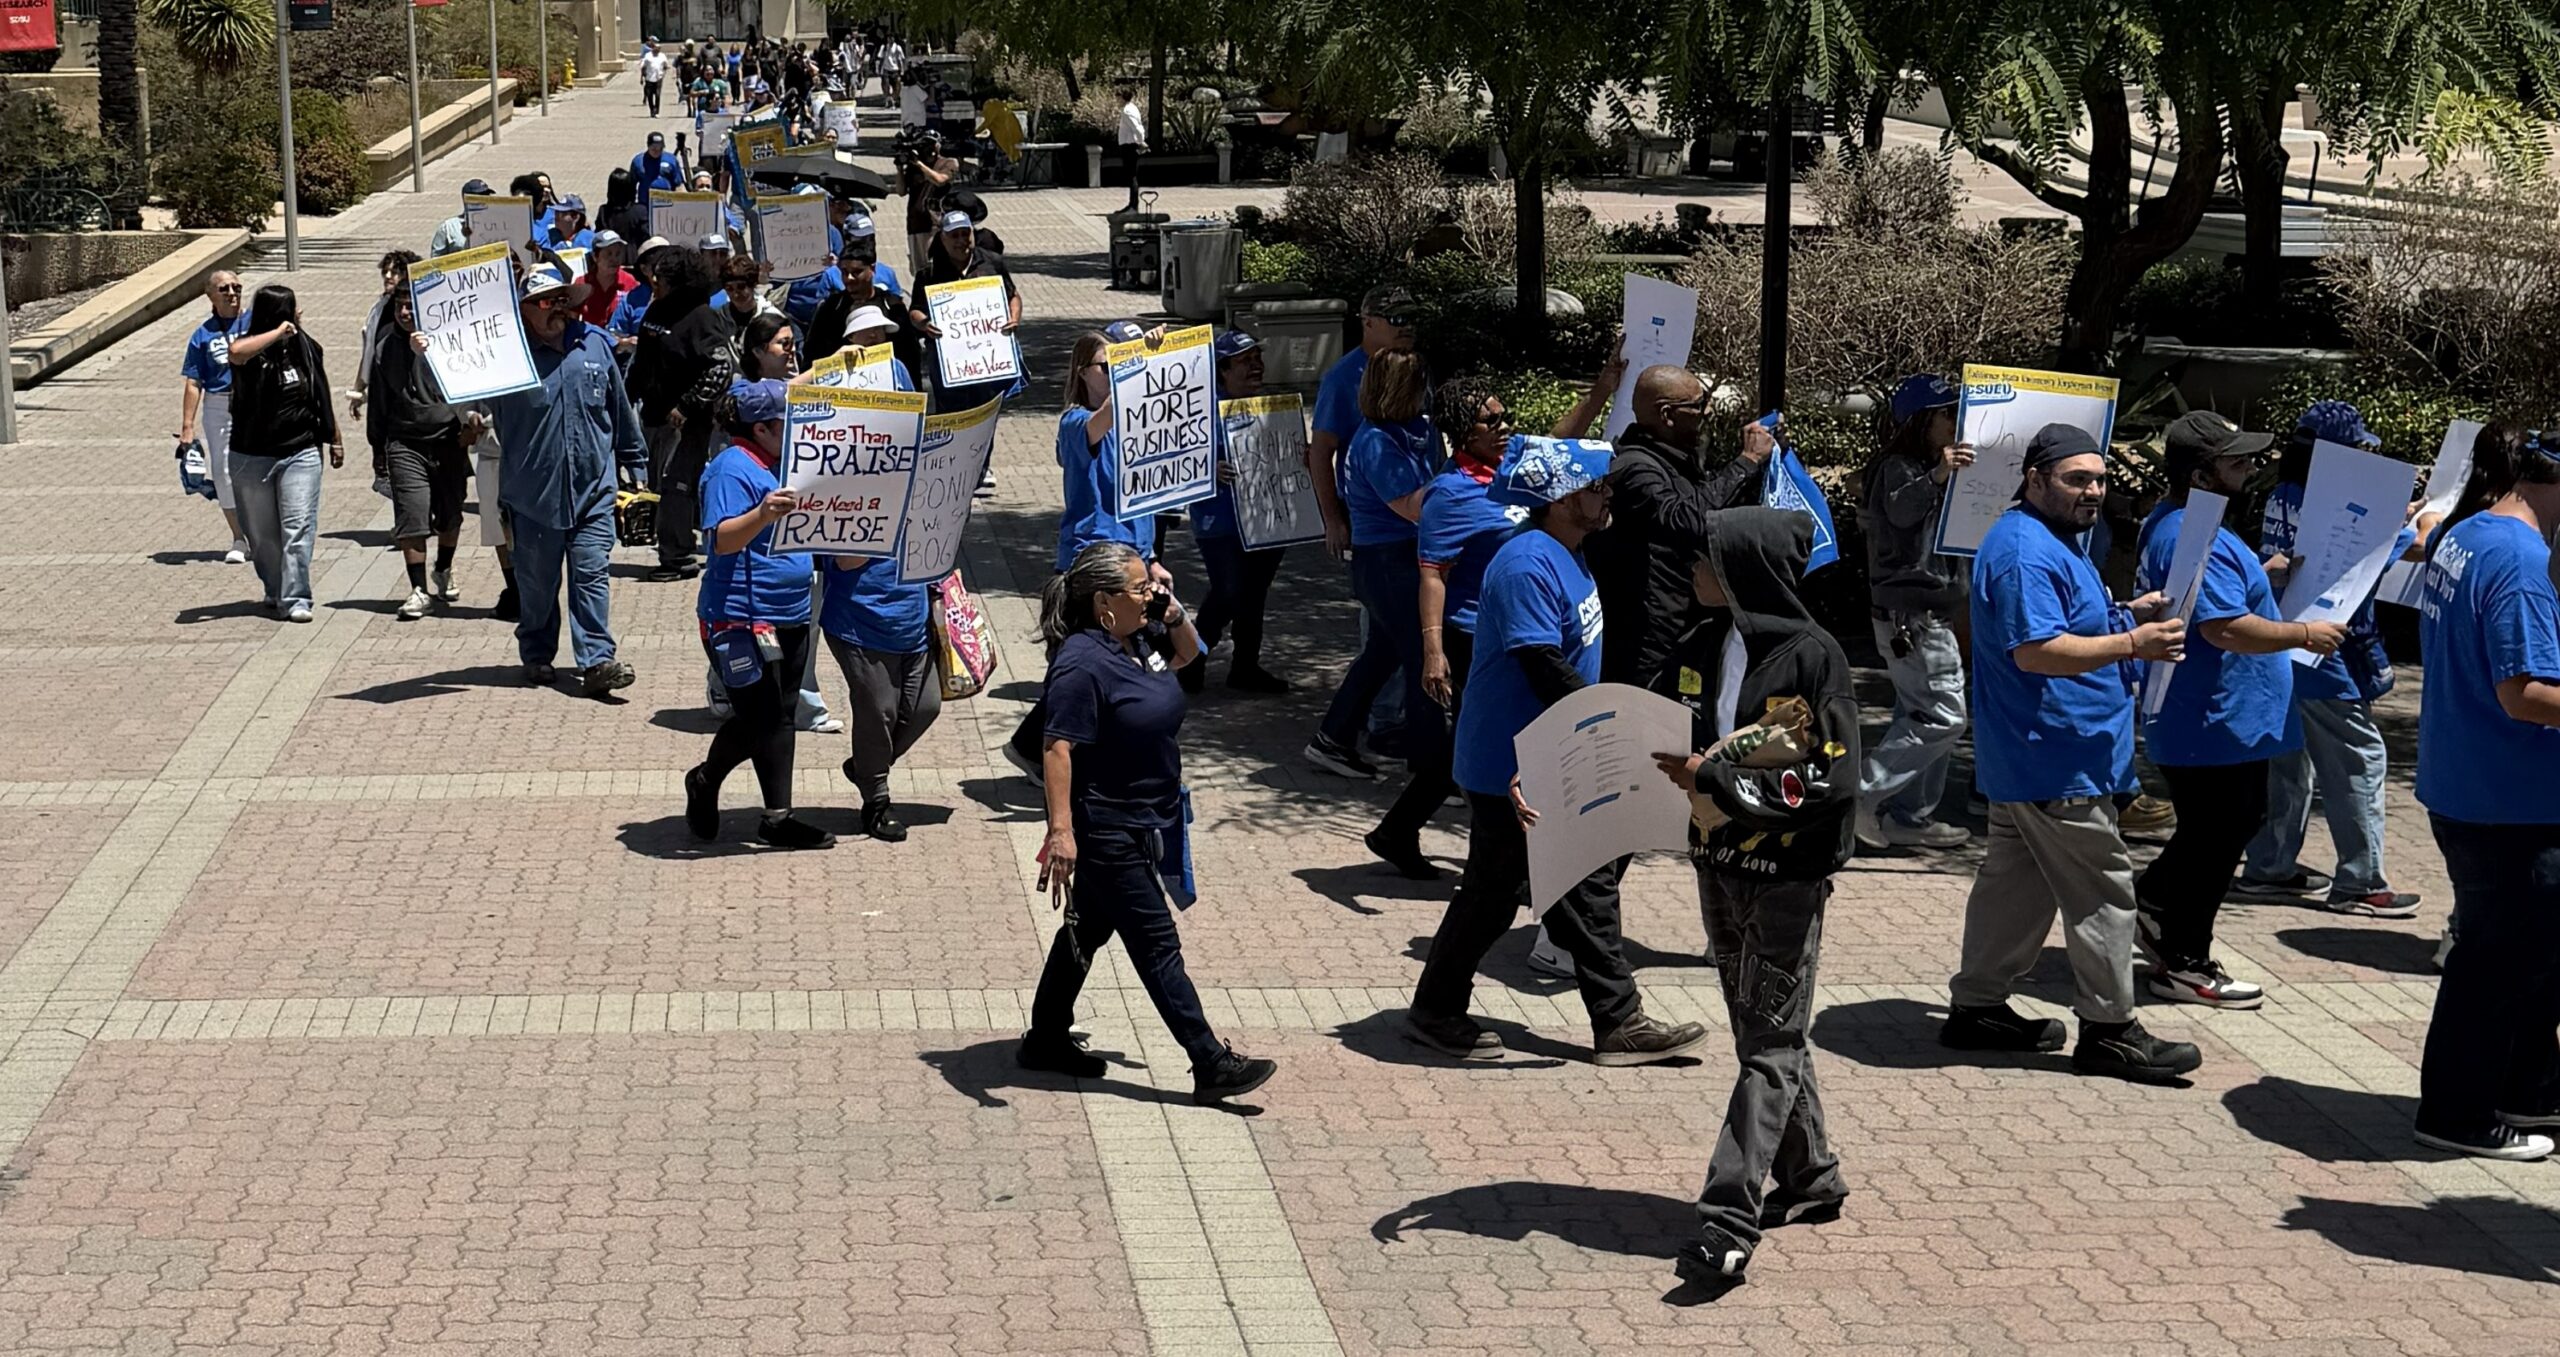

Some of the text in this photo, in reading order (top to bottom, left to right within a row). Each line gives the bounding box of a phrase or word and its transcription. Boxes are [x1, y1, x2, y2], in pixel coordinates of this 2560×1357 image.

[447, 263, 500, 294] UNION
[426, 294, 479, 331] STAFF
[949, 315, 1004, 339] STRIKE
[469, 313, 507, 344] THE
[1146, 362, 1187, 396] NO
[1967, 383, 2012, 394] CSUEU
[1126, 386, 1204, 432] MORE
[800, 424, 892, 444] More Than
[1122, 416, 1209, 466] BUSINESS
[791, 442, 918, 476] PRAISE
[1122, 454, 1209, 497] UNIONISM
[798, 493, 882, 512] We Need a
[781, 513, 888, 544] RAISE
